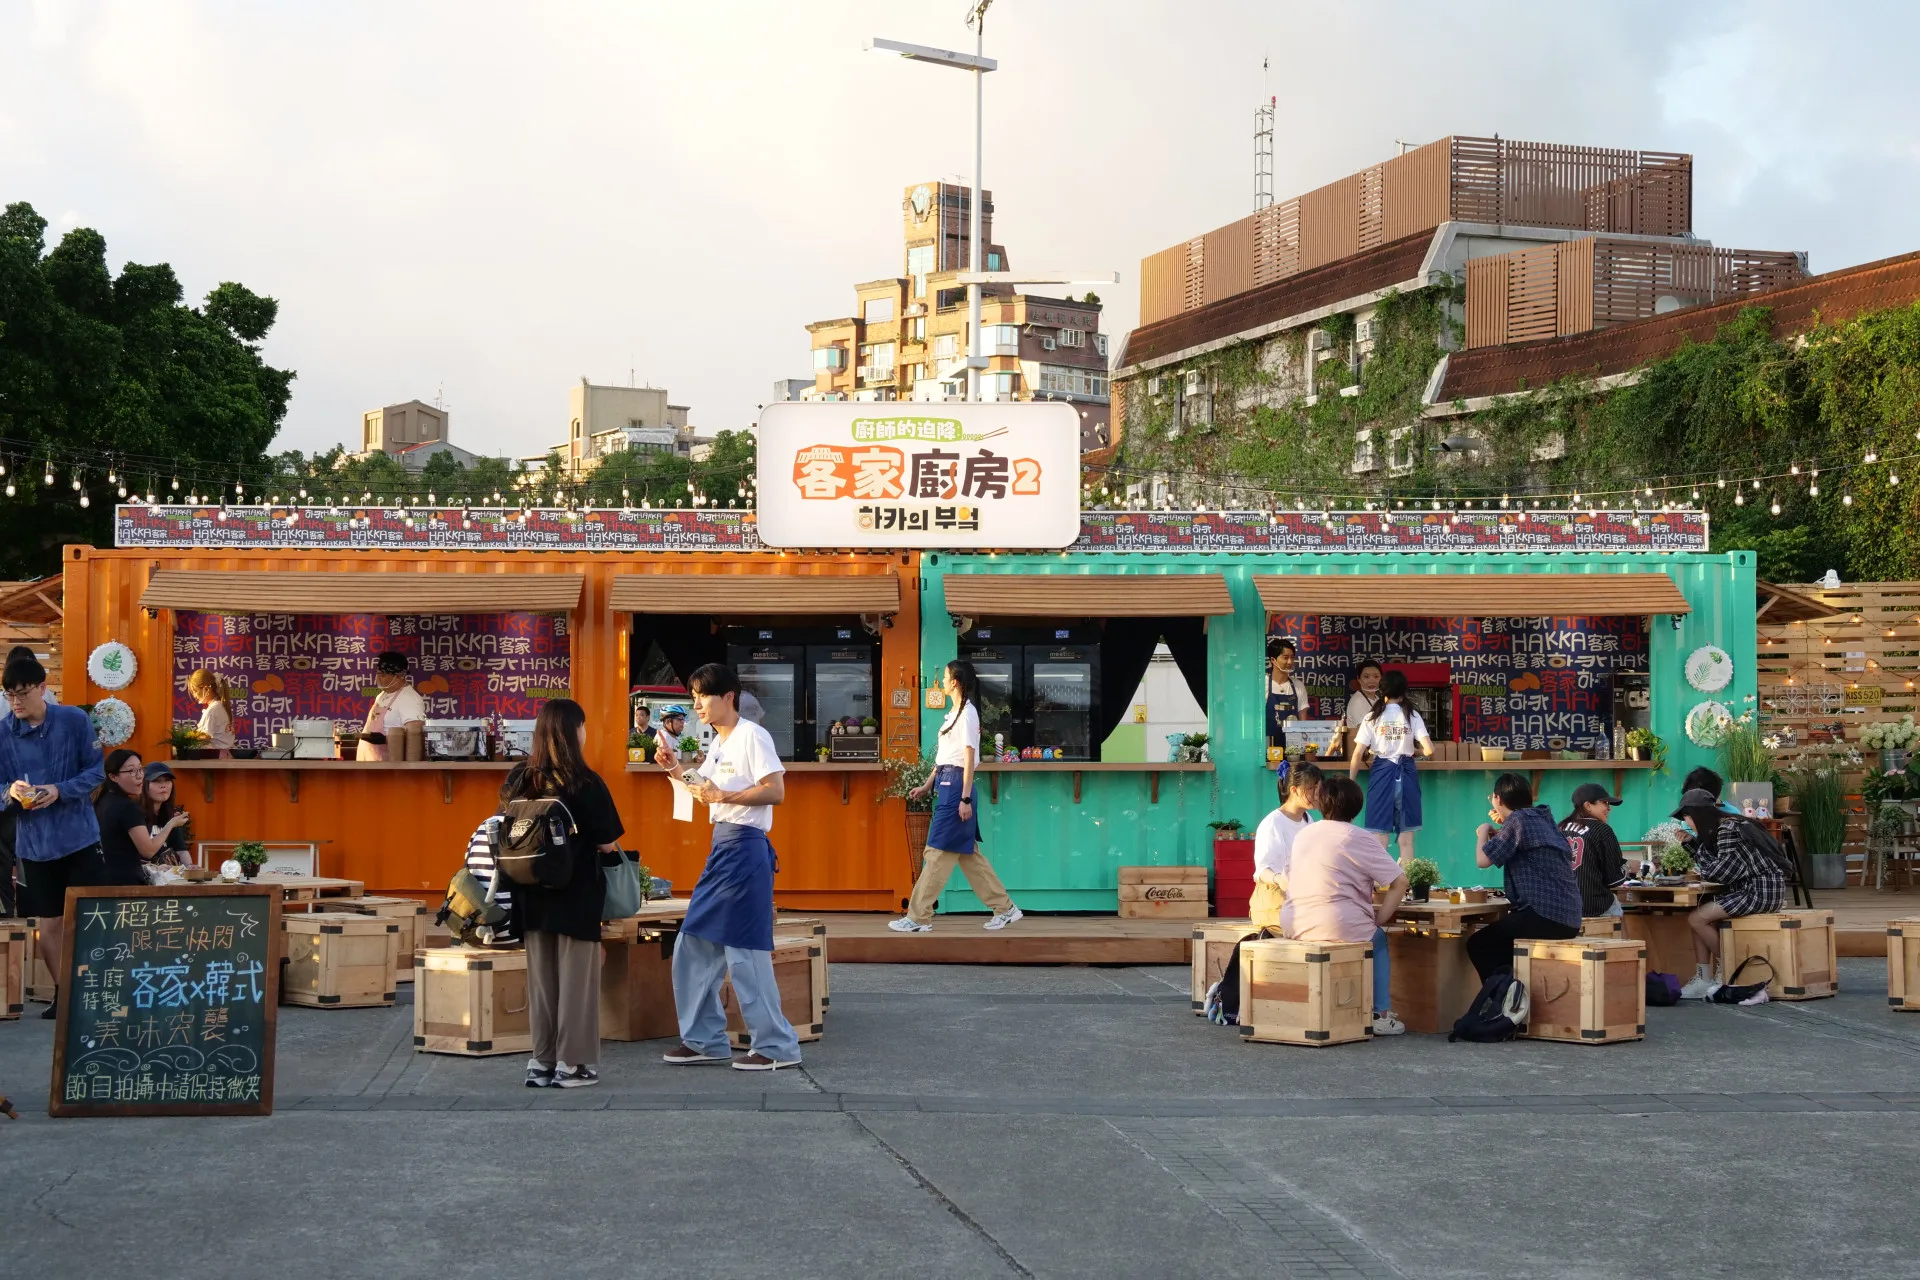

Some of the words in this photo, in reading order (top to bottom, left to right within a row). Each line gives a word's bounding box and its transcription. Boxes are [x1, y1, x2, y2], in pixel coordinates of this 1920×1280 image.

[855, 420, 956, 440] 廚師的迫降
[859, 506, 929, 531] 하카의
[193, 528, 230, 539] HAKKA
[272, 529, 309, 540] HAKKA
[350, 530, 387, 540] HAKKA
[429, 530, 466, 541] HAKKA
[507, 531, 544, 541] HAKKA
[585, 532, 622, 542] HAKKA
[664, 532, 700, 542] HAKKA
[1116, 534, 1152, 544] HAKKA
[1193, 534, 1229, 544] HAKKA
[1270, 534, 1306, 544] HAKKA
[1347, 534, 1382, 544] HAKKA
[1423, 534, 1459, 544] HAKKA
[1500, 534, 1535, 544] HAKKA
[1576, 534, 1611, 544] HAKKA
[1652, 534, 1687, 544] HAKKA
[224, 616, 250, 635] 客家
[298, 613, 388, 635] HAKKA
[390, 616, 416, 635] 客家
[1321, 616, 1346, 634] 客家
[203, 634, 254, 652] 하카
[256, 632, 332, 654] HAKKA
[334, 635, 366, 654] 客家
[369, 634, 420, 653] 하카
[421, 633, 497, 655] HAKKA
[499, 636, 530, 654] 客家
[1300, 633, 1350, 651] 하카
[1352, 631, 1426, 653] HAKKA
[1428, 634, 1459, 652] 客家
[1461, 632, 1511, 650] 하카
[1512, 631, 1586, 653] HAKKA
[1588, 634, 1618, 652] 客家
[191, 655, 253, 670] HAKKA
[256, 654, 290, 670] 客家
[292, 654, 354, 670] 하카
[421, 655, 455, 671] 客家
[457, 655, 518, 670] 하카
[1451, 654, 1510, 668] HAKKA
[1512, 652, 1546, 668] 客家
[1547, 652, 1607, 668] 하카
[322, 671, 362, 692] 하카
[487, 672, 527, 692] 하카
[1456, 671, 1506, 685] HAKKA
[252, 693, 293, 714] 하카
[1481, 696, 1507, 715] 客家
[1509, 691, 1549, 711] 하카
[1846, 690, 1862, 700] KISS
[1864, 691, 1879, 700] 520
[1512, 712, 1586, 734] HAKKA
[1512, 734, 1546, 750] 客家
[83, 899, 182, 930] 大稻埕
[132, 926, 234, 952] 限定快閃
[95, 1007, 229, 1048] 美味突襲
[65, 1073, 261, 1100] 節目拍攝中請保持微笑
